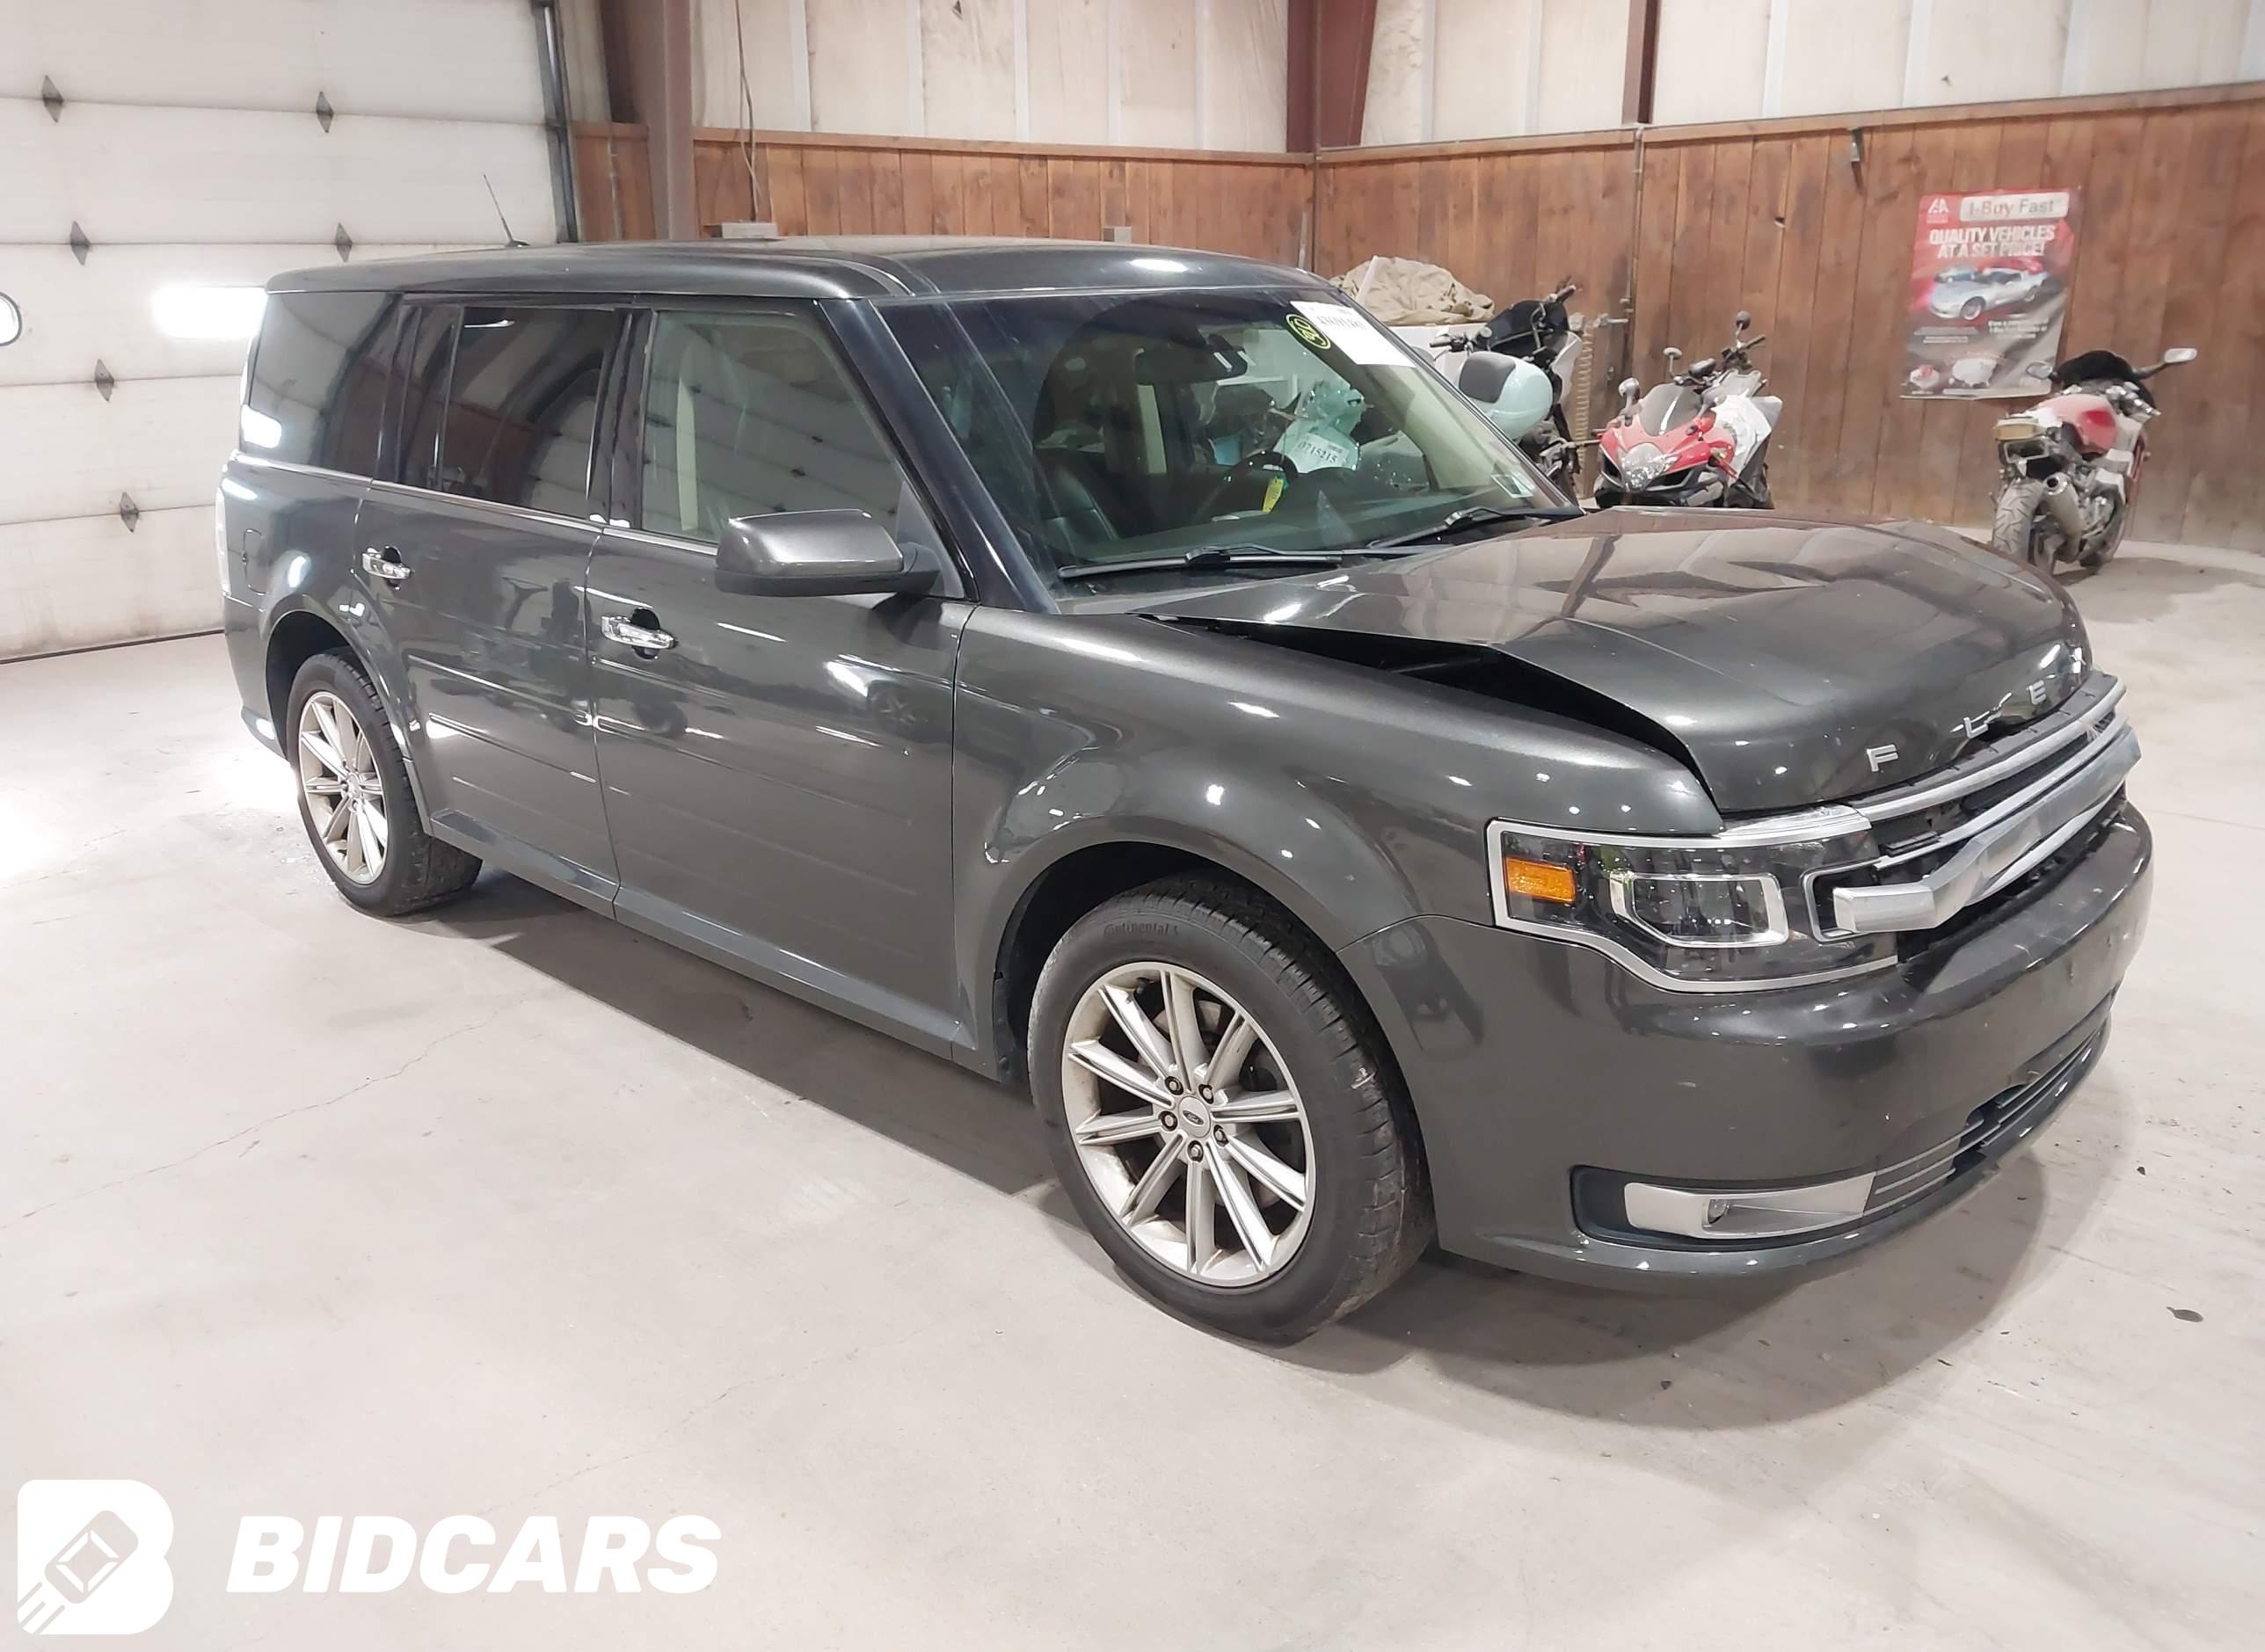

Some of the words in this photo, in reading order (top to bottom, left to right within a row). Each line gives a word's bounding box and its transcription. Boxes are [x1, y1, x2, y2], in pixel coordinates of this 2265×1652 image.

[1969, 200, 2013, 216] I-Buy
[2019, 197, 2055, 214] Fast
[1929, 226, 1988, 245] QUALITY
[1989, 224, 2056, 243] VEHICLES
[1937, 243, 1958, 259] AT
[1956, 243, 1970, 258] A
[1971, 242, 1999, 258] SET
[1999, 239, 2046, 258] PRICE!
[1103, 921, 1170, 937] Continental
